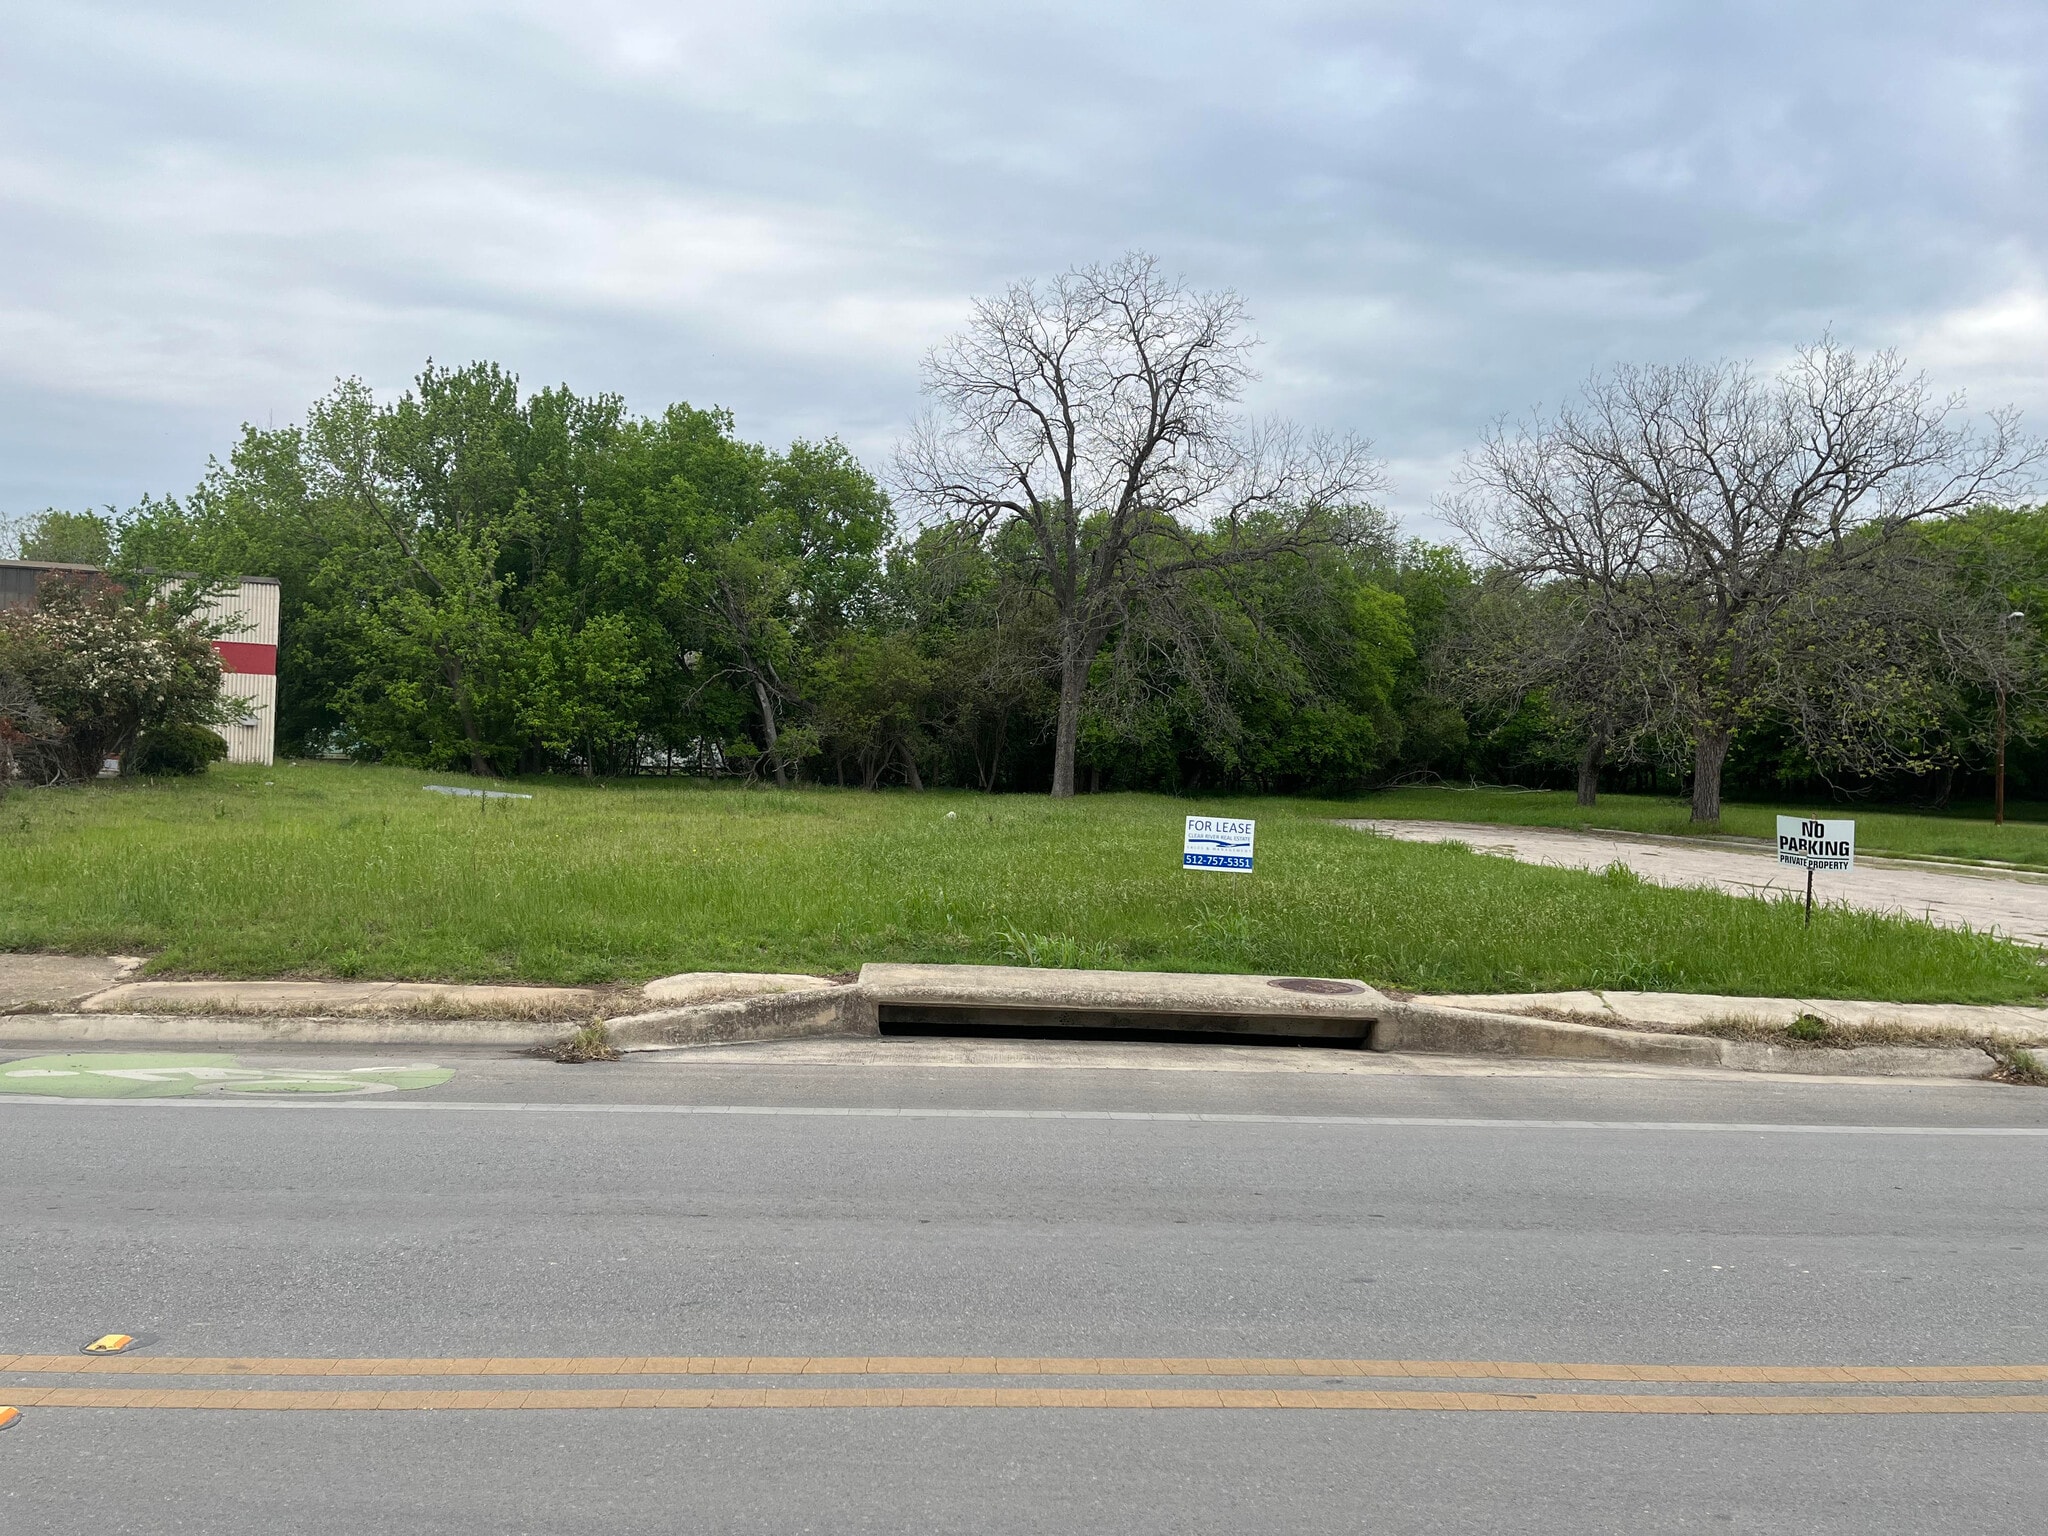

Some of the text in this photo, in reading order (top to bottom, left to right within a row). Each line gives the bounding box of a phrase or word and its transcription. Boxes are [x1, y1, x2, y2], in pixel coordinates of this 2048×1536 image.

[1188, 820, 1252, 835] FOR LEASE
[1801, 820, 1825, 838] NO
[1780, 835, 1850, 857] PARKING
[1185, 854, 1251, 868] 512-757-5351
[1780, 854, 1849, 870] PRIVATE PROPERTY
